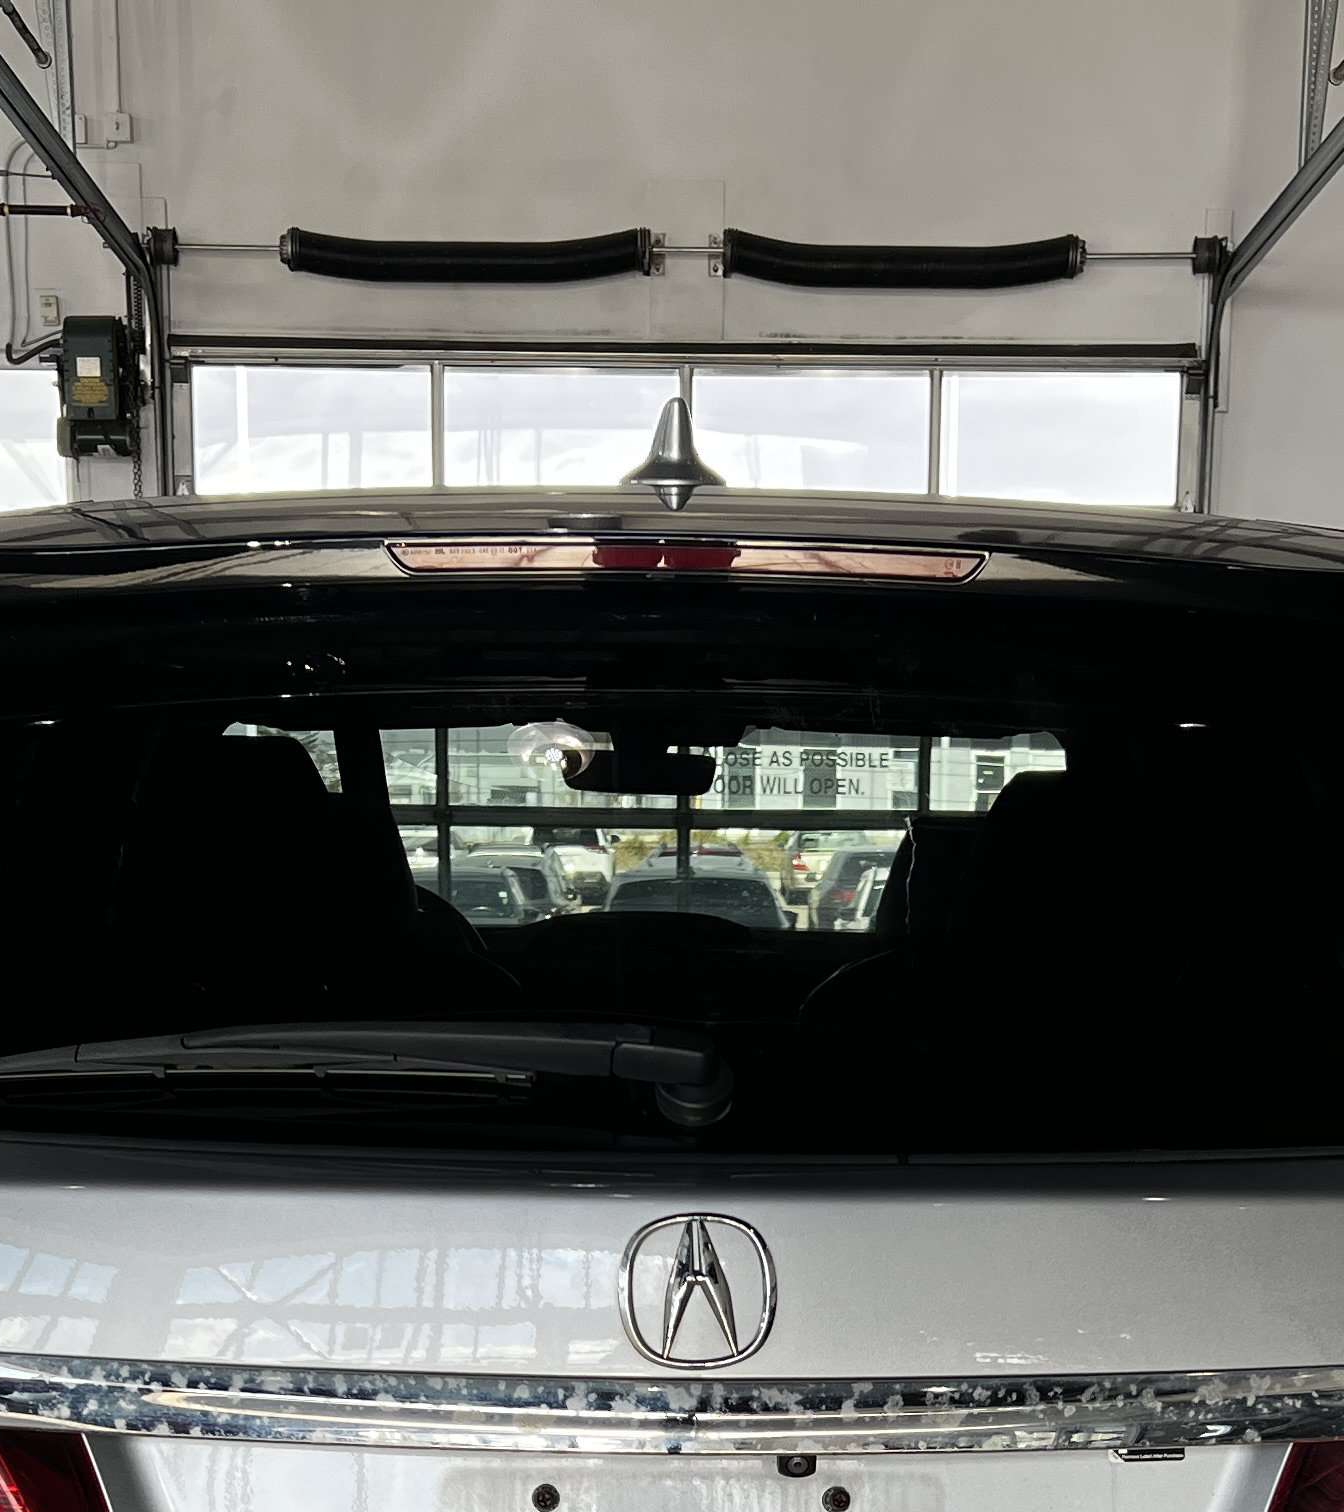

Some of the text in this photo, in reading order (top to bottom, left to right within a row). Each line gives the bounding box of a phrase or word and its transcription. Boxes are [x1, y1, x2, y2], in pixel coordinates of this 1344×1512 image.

[705, 748, 889, 769] LOSE AS POSSIBLE
[760, 775, 804, 795] WILL
[809, 777, 865, 796] OPEN.
